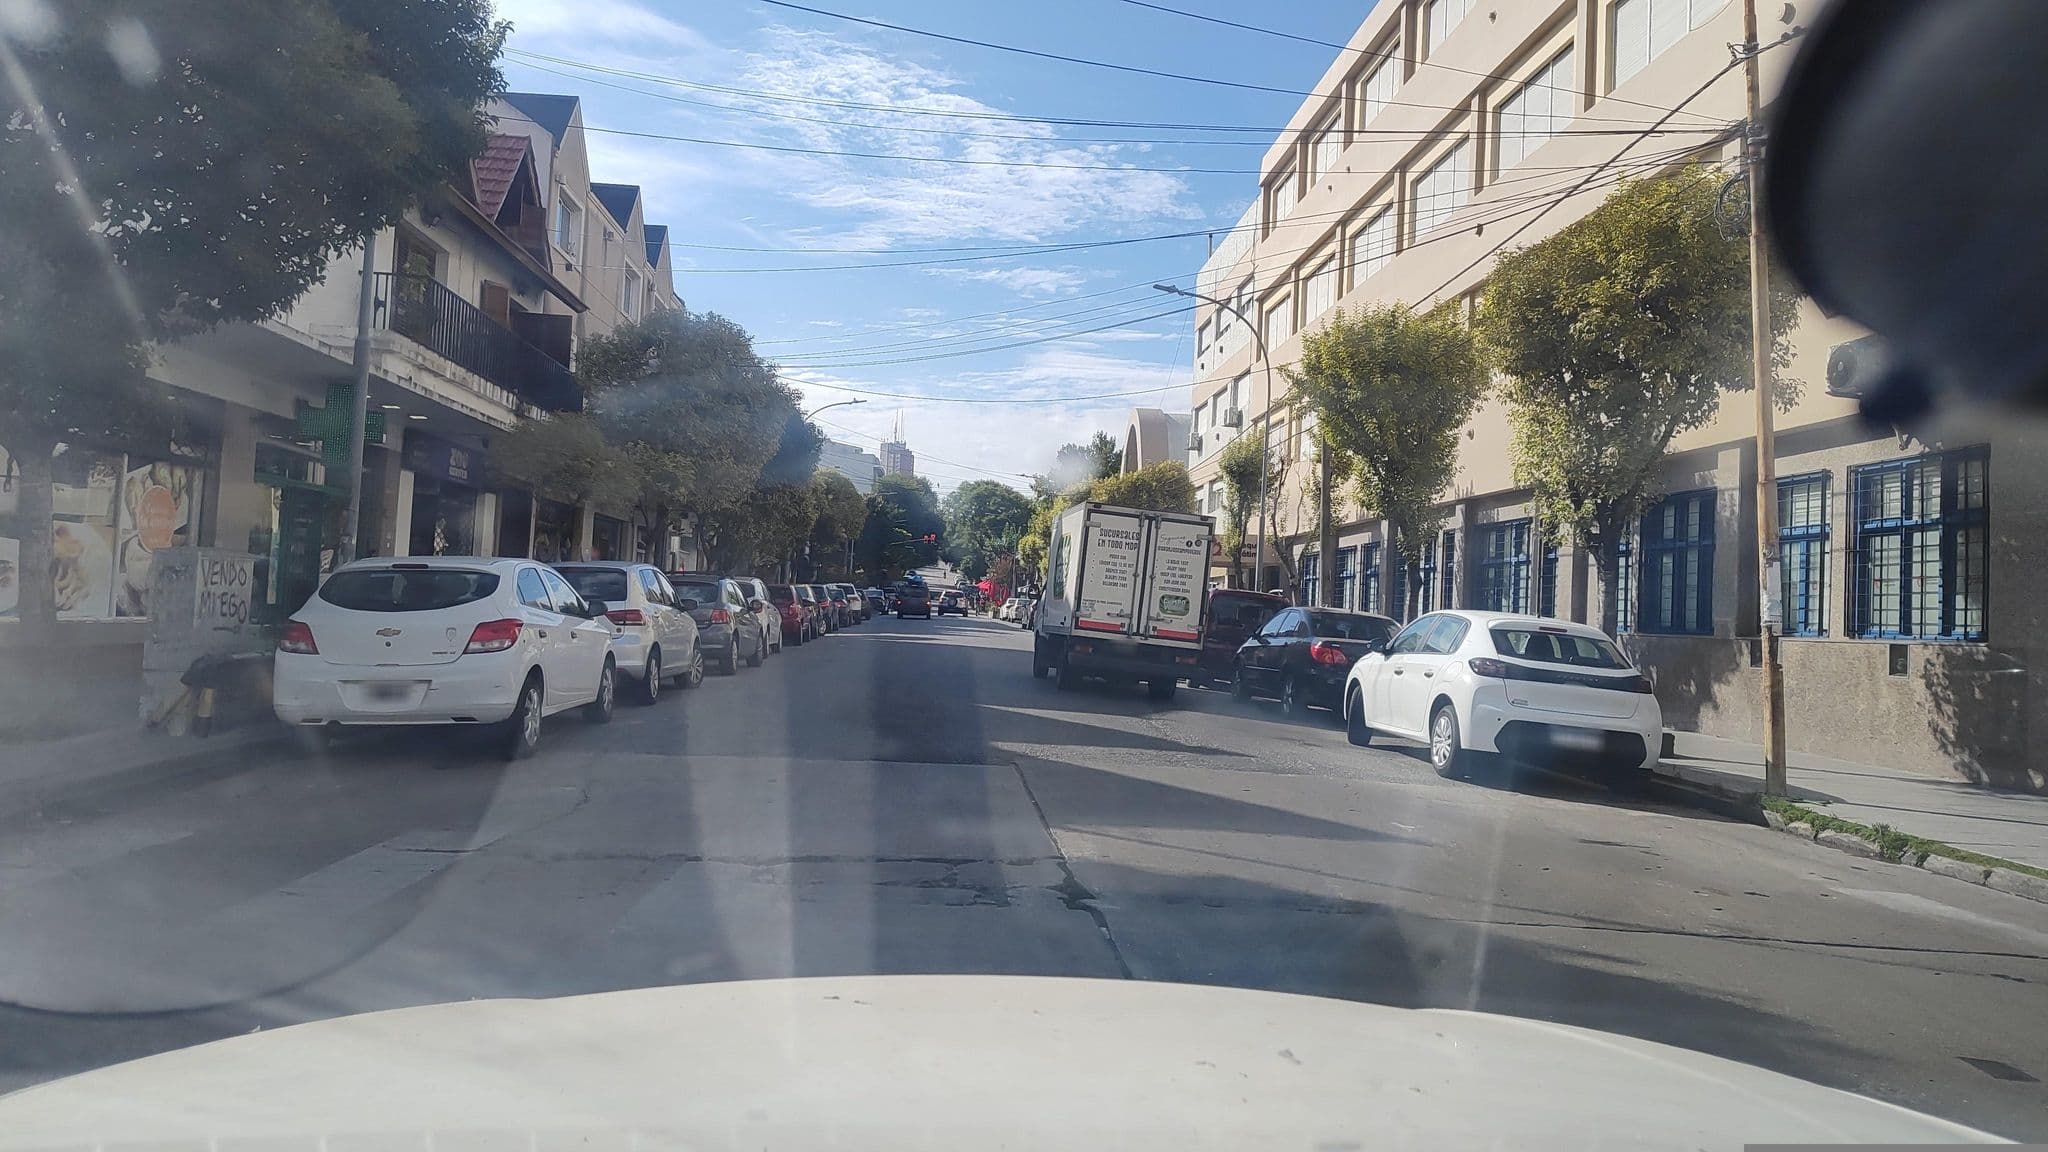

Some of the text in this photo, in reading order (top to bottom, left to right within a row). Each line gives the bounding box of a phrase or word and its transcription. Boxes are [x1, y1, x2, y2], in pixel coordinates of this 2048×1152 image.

[1098, 539, 1106, 548] EN
[1108, 540, 1123, 550] TODO
[201, 558, 247, 588] VENDO
[220, 591, 248, 624] EGO
